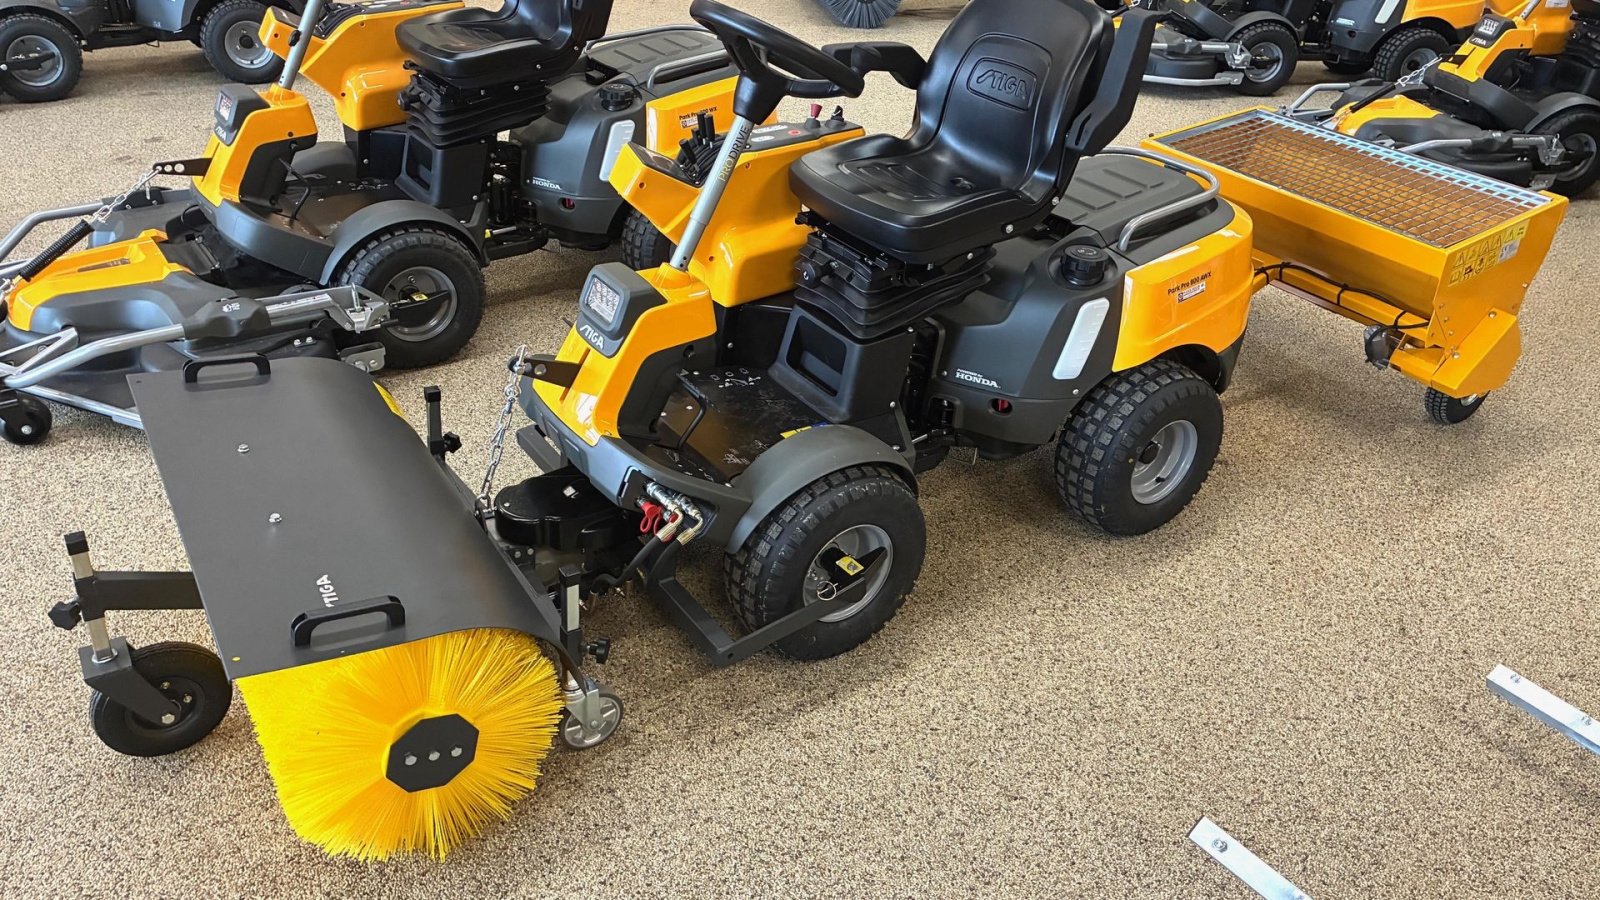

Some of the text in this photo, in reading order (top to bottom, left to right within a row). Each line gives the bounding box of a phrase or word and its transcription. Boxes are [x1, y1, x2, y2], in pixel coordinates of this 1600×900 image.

[976, 68, 1027, 100] STIGA
[532, 179, 562, 190] HONDA
[1168, 284, 1180, 295] Park
[1180, 281, 1190, 289] Pro
[579, 324, 604, 350] STIGA
[955, 371, 999, 388] HONDA
